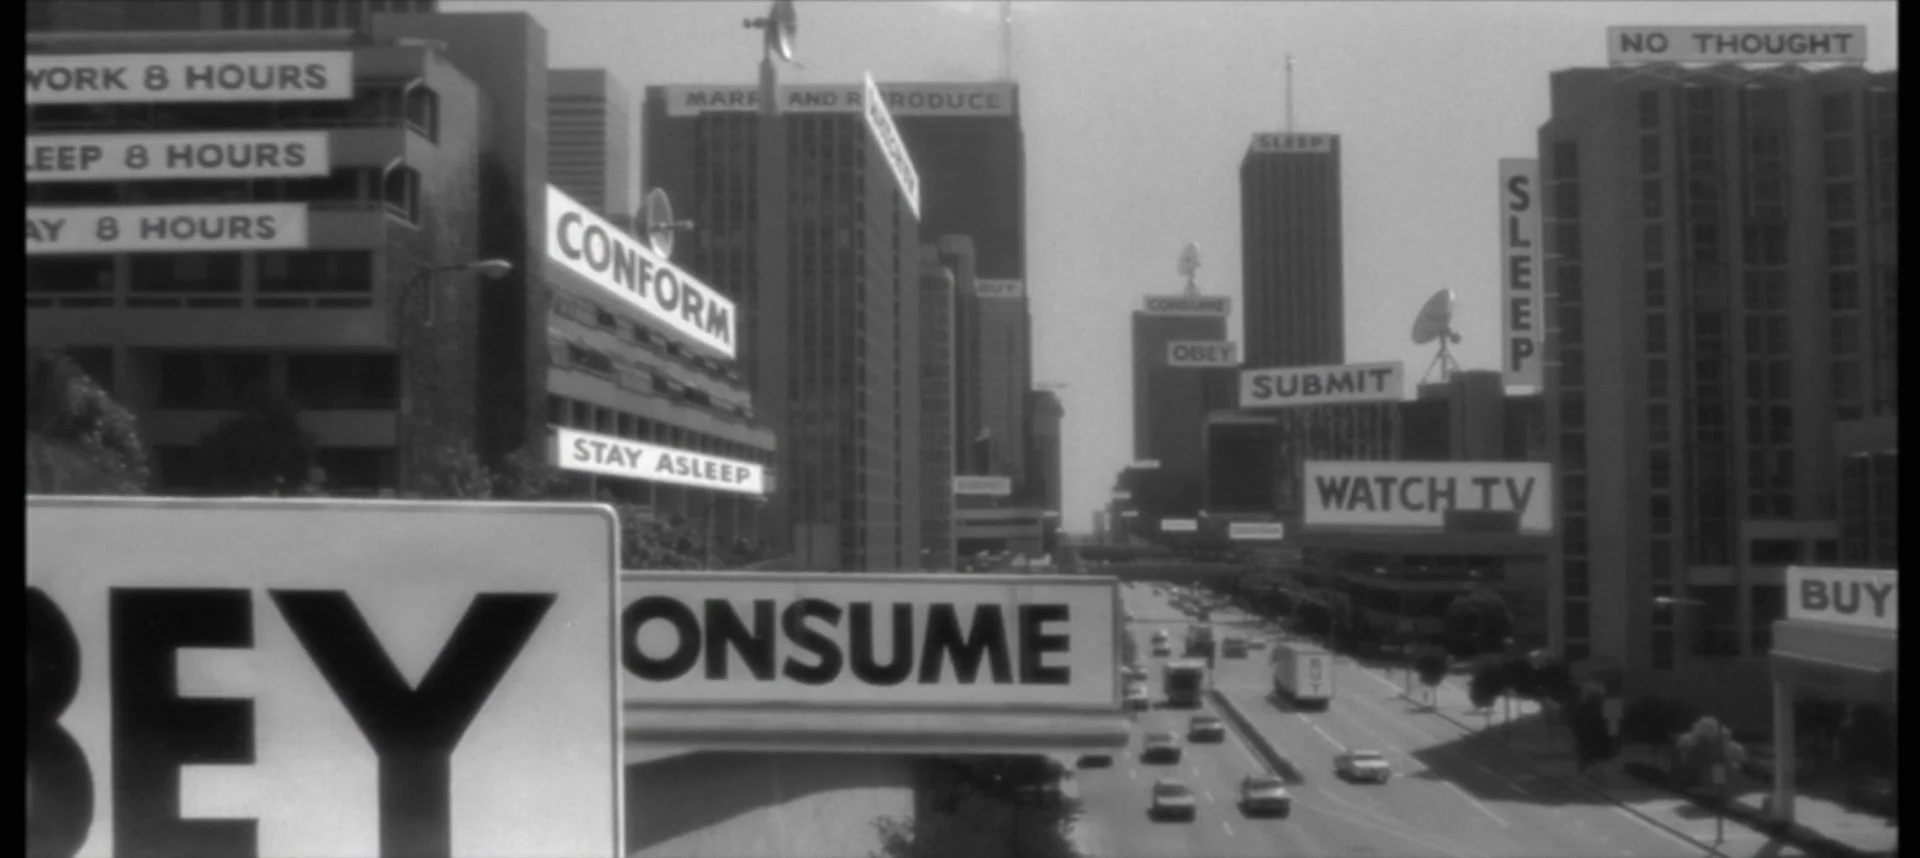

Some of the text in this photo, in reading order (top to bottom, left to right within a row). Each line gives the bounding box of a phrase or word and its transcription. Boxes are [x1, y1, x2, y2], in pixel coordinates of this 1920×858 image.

[1620, 32, 1853, 55] NO THOUGHT
[143, 66, 169, 90] 8
[185, 63, 328, 91] HOURS
[686, 91, 1000, 109] MARR AND RRODUCE
[124, 144, 149, 169] 8
[165, 142, 306, 169] HOURS
[95, 216, 119, 241] 8
[139, 214, 277, 241] HOURS
[557, 212, 731, 346] CONFORM
[1507, 175, 1534, 372] SLEEP
[1173, 344, 1231, 362] OBEY
[1252, 369, 1394, 400] SUBMIT
[573, 438, 752, 486] STAY ASLEEP
[1315, 475, 1535, 514] WATCH TV
[1801, 579, 1893, 618] BUY
[621, 595, 1070, 686] ONSUME
